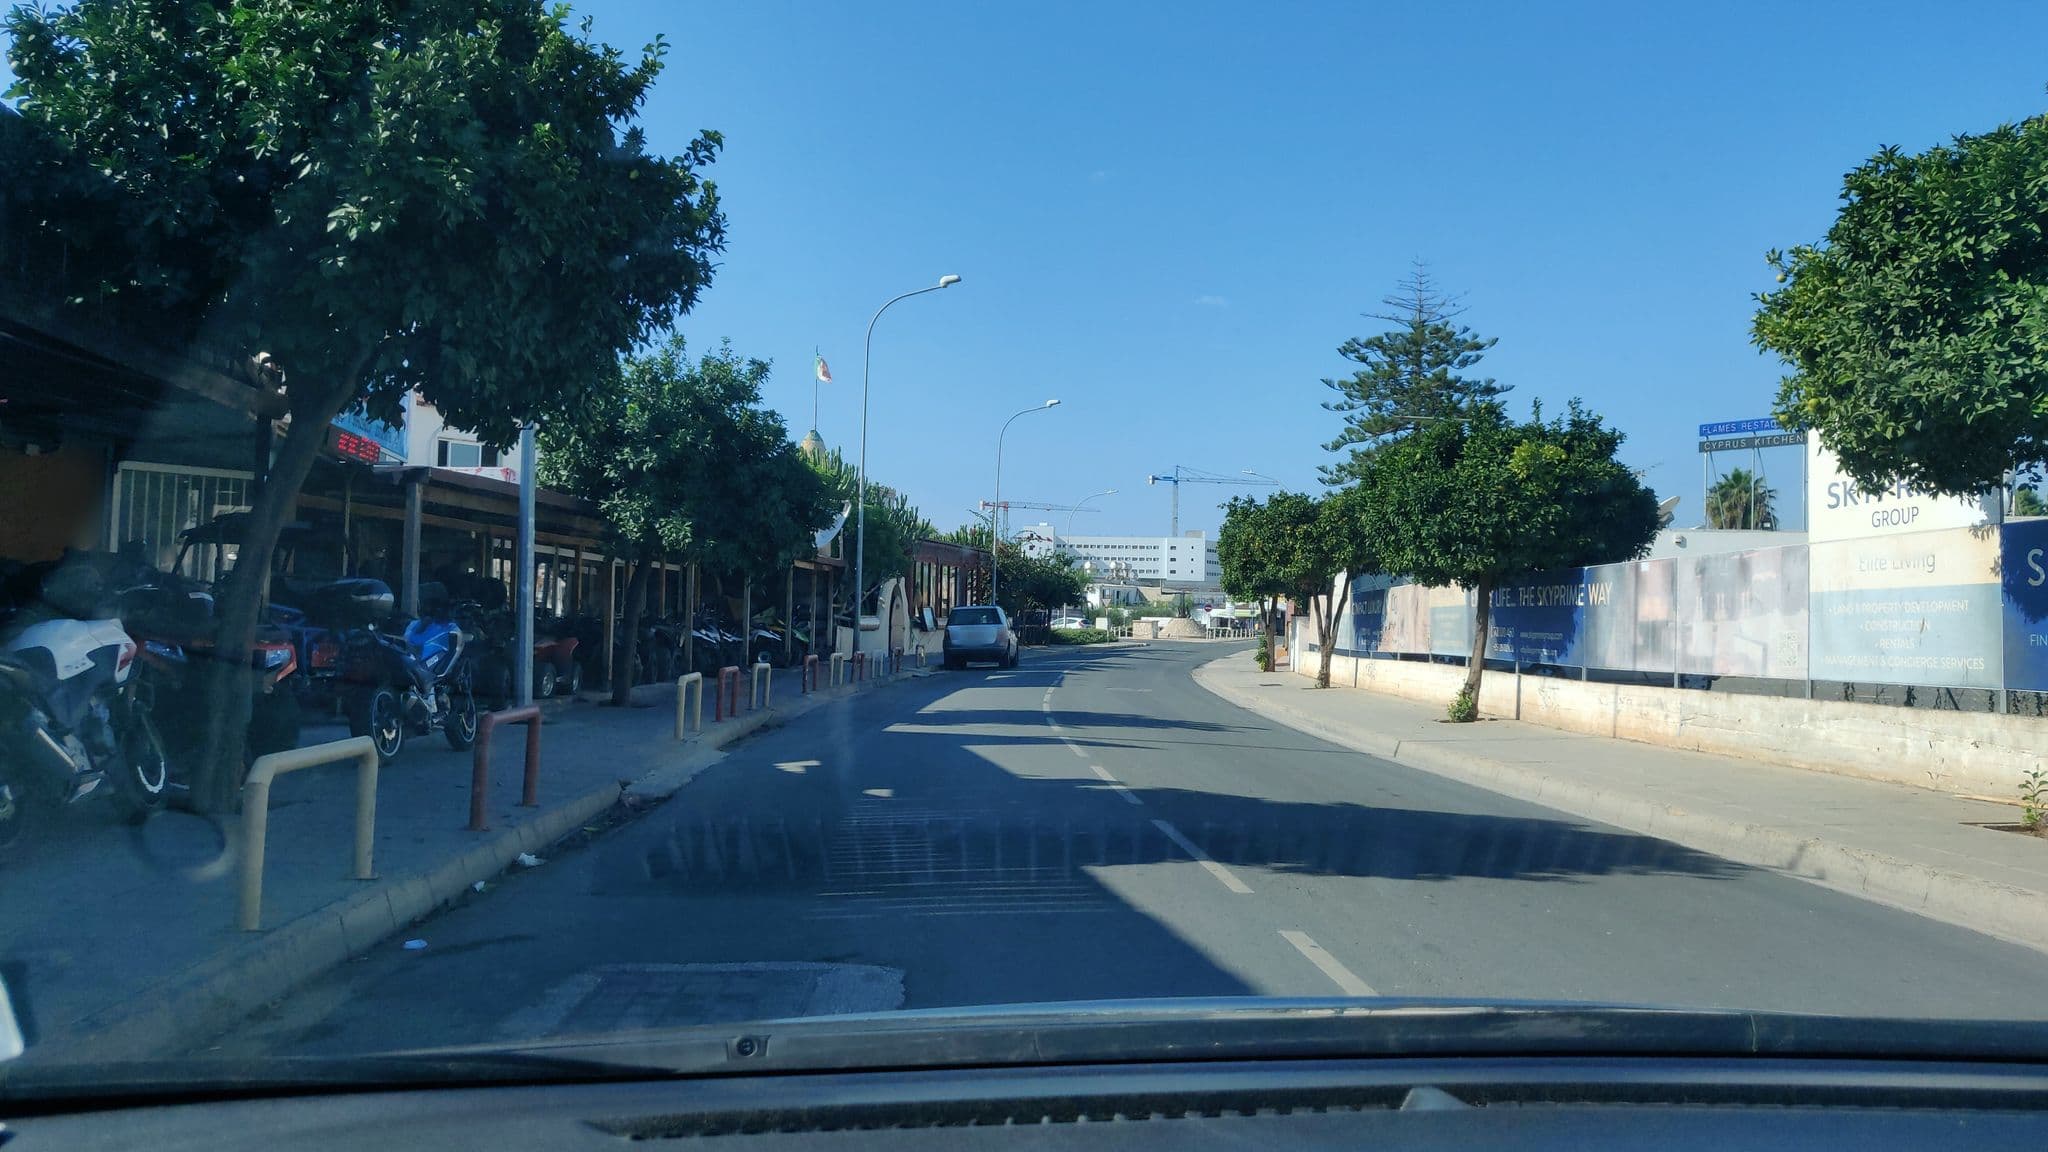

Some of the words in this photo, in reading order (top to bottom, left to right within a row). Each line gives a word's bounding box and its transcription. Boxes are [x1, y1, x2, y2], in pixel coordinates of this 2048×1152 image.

[1703, 423, 1736, 434] FLAMES
[1704, 439, 1746, 451] CYPRUS
[1755, 434, 1803, 446] KITCHEN
[1872, 506, 1919, 528] GROUP
[1519, 585, 1535, 608] THE
[1537, 583, 1584, 608] SKYPRIME
[1588, 581, 1613, 607] WAY
[1904, 600, 1968, 613] DEVELOPMENT
[1880, 638, 1915, 649] RENTALS
[1824, 655, 1878, 667] MANAGEMENT
[1887, 656, 1938, 669] CONCIERGE
[1941, 657, 1984, 671] SERVICES
